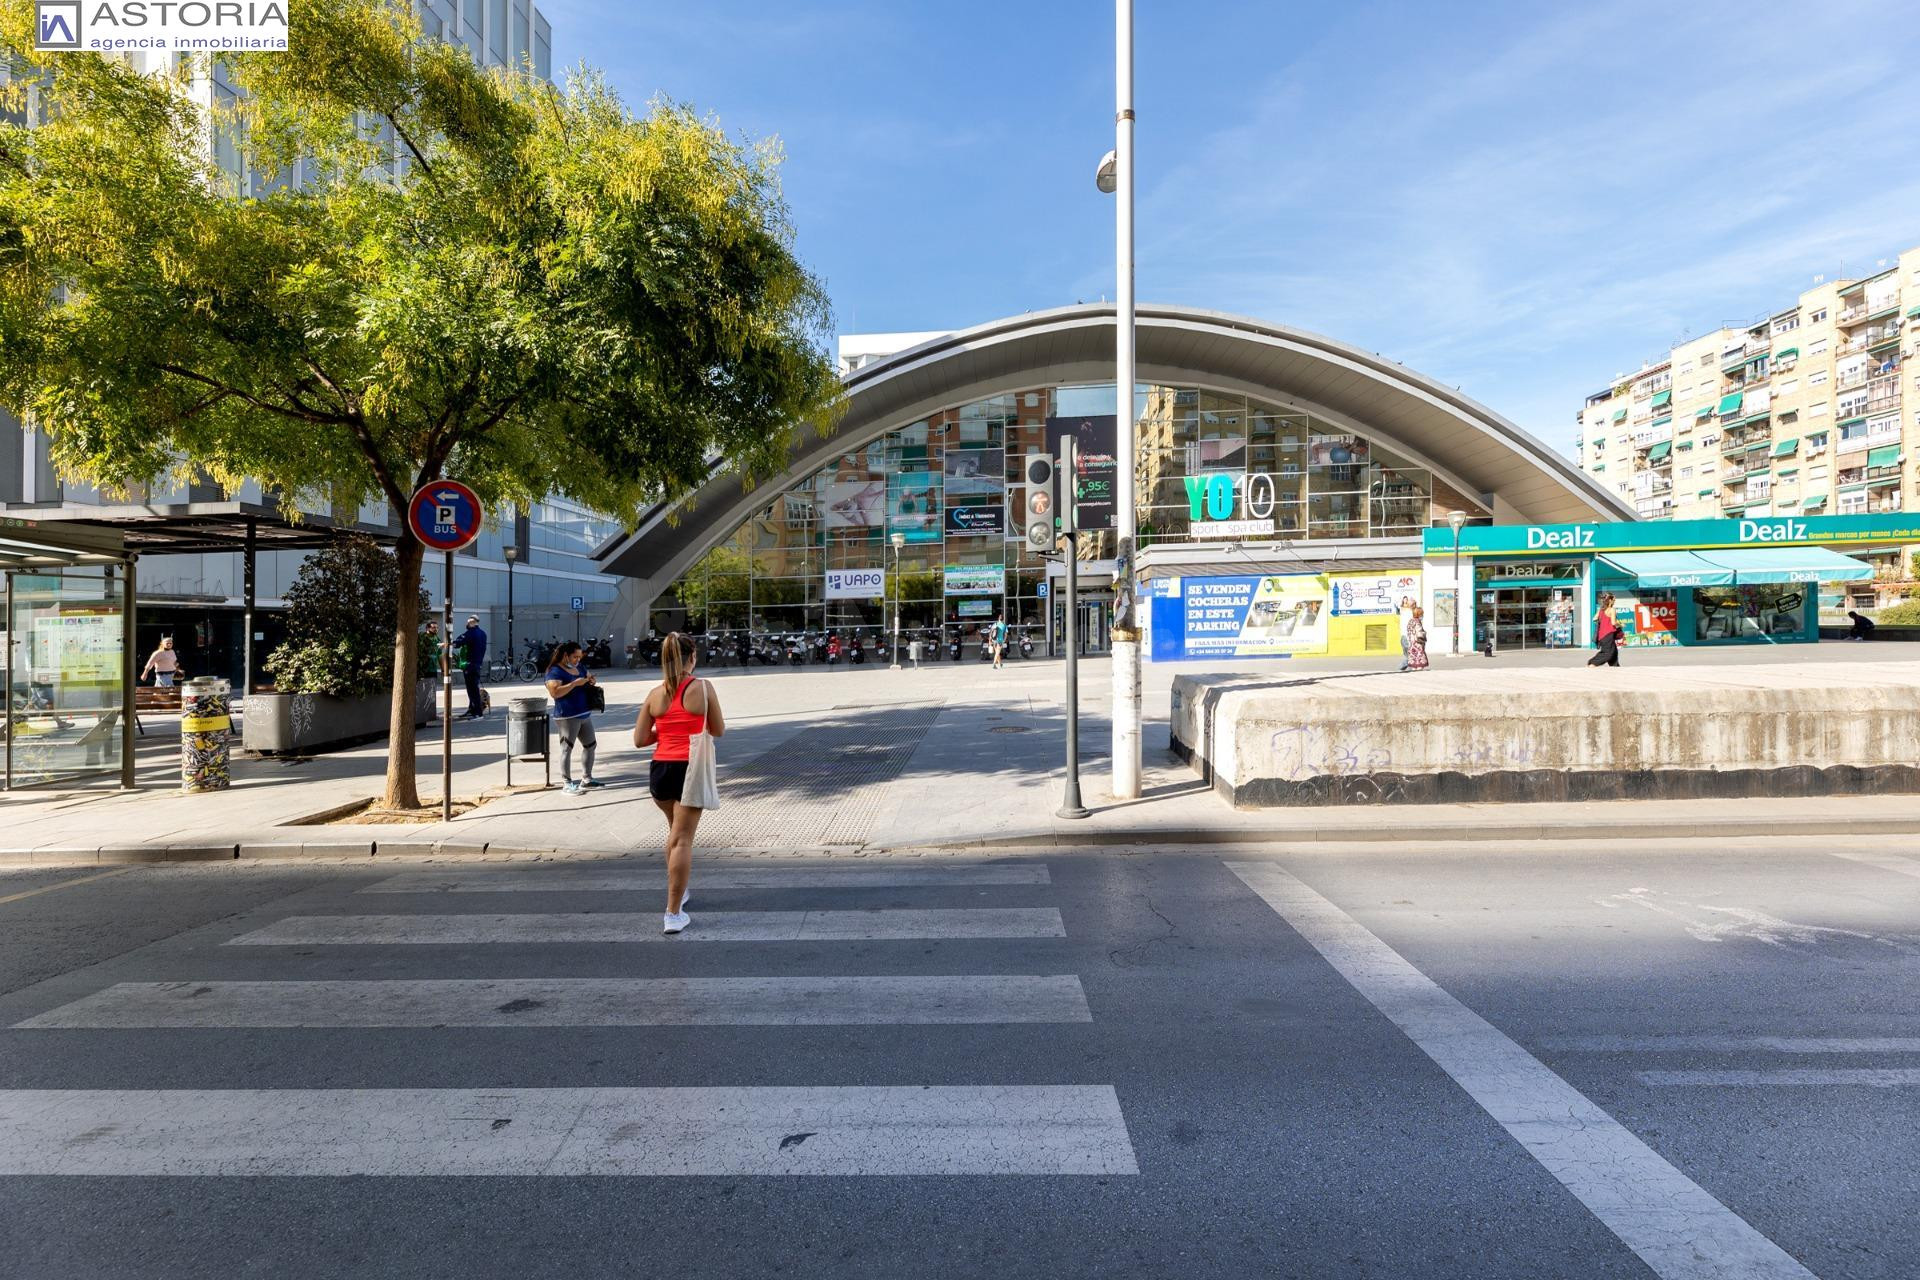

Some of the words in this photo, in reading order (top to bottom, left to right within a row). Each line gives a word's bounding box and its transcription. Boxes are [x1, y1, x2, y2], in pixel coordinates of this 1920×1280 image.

[440, 507, 451, 522] P
[434, 525, 457, 534] BUS
[1191, 523, 1218, 535] sport
[1227, 523, 1246, 534] spa
[1249, 520, 1273, 532] club
[1739, 519, 1807, 542] Dealz
[1527, 525, 1595, 549] Dealz
[1505, 564, 1546, 577] Dealz
[844, 573, 881, 586] UAPO
[1670, 575, 1701, 586] Dealz
[1789, 571, 1820, 582] Dealz
[1188, 585, 1203, 595] SE
[1204, 584, 1251, 594] VENDEN
[1188, 597, 1249, 607] COCHERAS
[1188, 609, 1203, 619] EN
[1206, 608, 1235, 619] ESTE
[1188, 621, 1240, 632] PARKING
